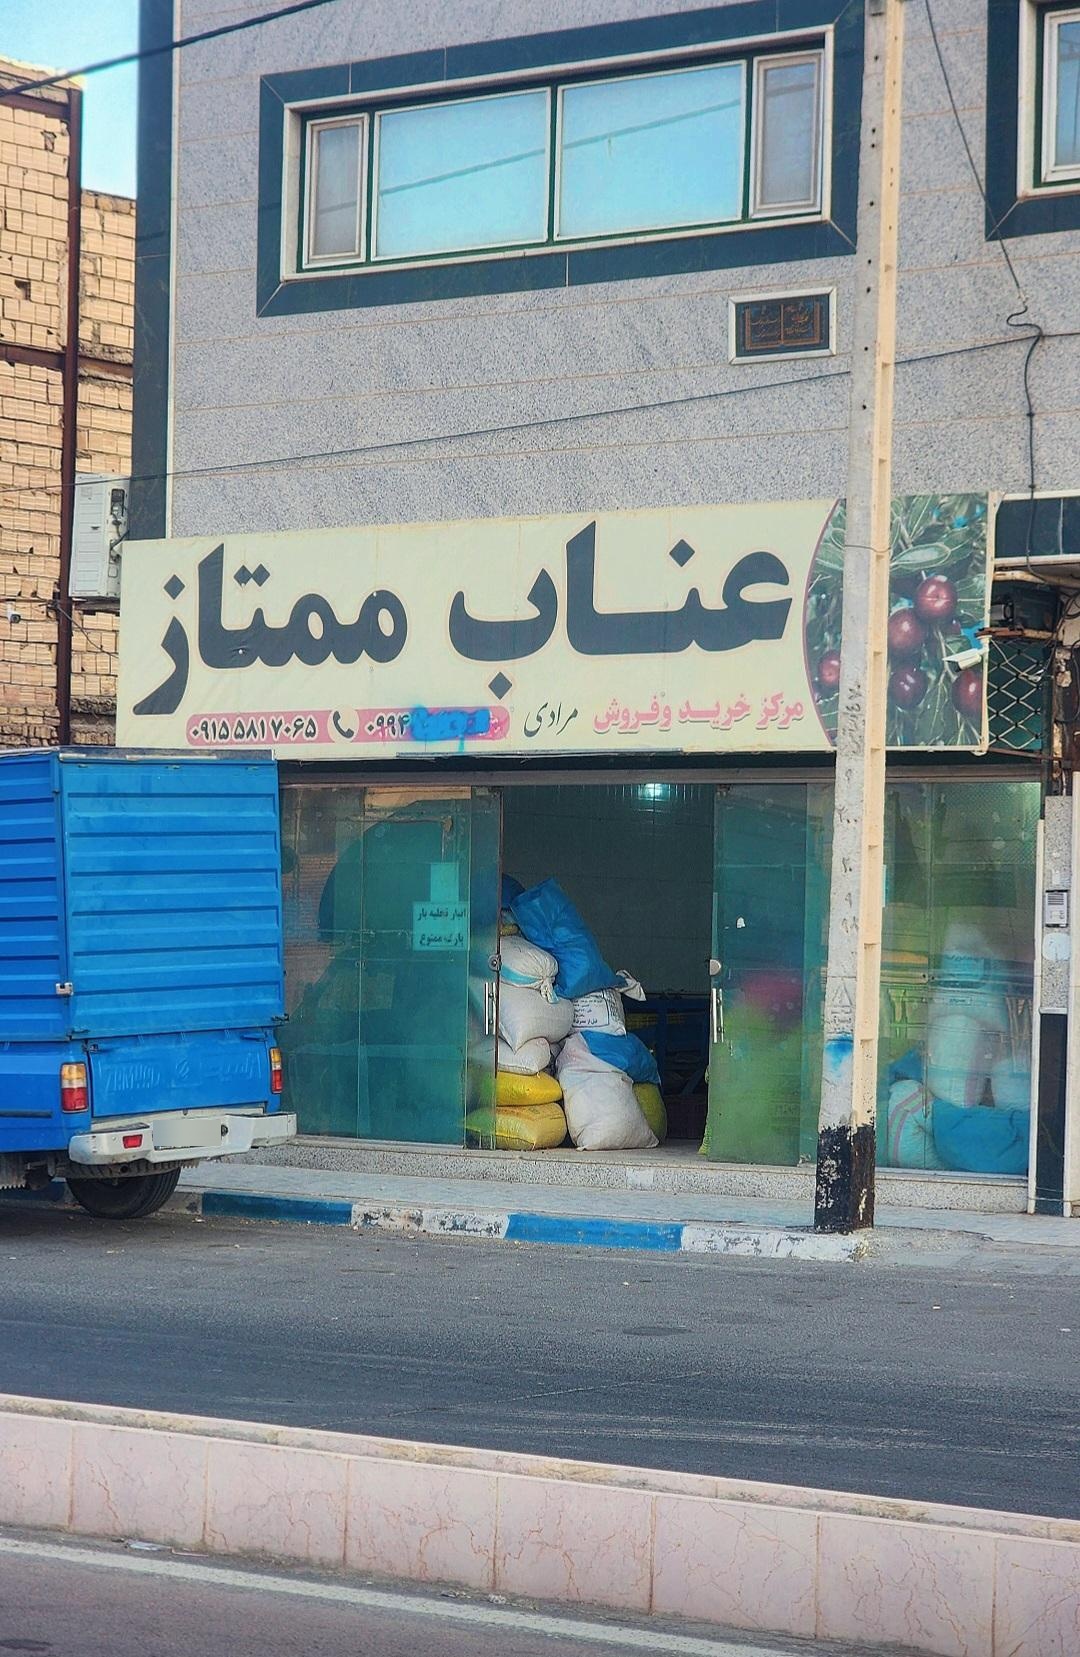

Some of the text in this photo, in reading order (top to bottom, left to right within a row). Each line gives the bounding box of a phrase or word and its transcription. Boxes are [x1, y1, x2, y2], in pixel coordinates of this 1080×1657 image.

[133, 520, 793, 716] عناب ممتاز
[523, 701, 579, 738] مرادی
[678, 693, 751, 731] خرید
[756, 691, 805, 729] مرکز
